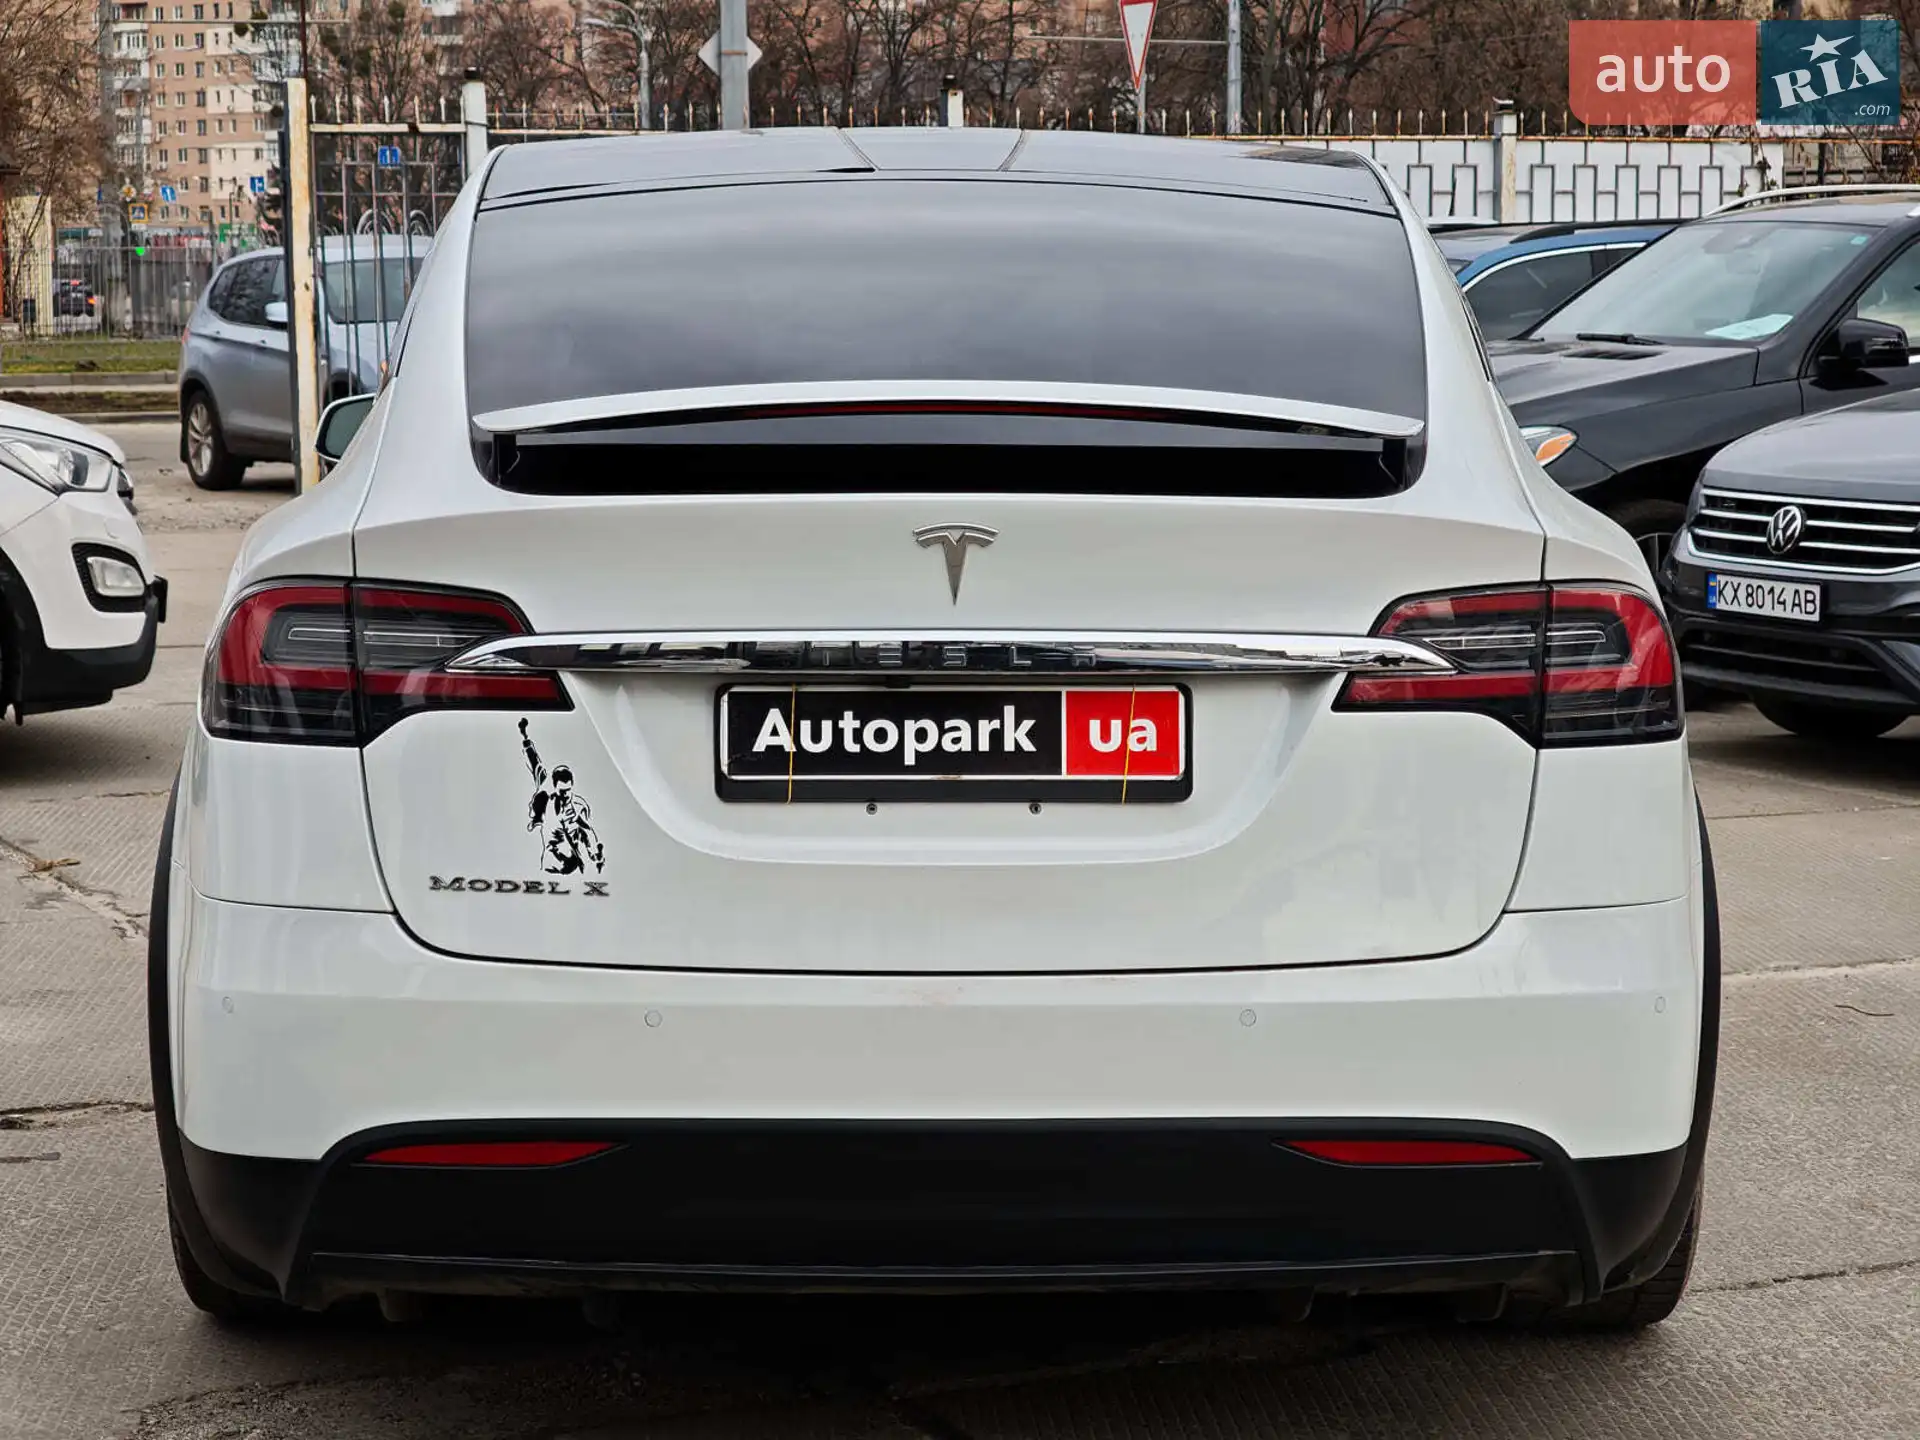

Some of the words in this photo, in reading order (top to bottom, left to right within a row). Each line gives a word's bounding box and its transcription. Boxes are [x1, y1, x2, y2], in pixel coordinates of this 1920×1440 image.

[1718, 579, 1741, 607] KX
[1745, 583, 1787, 613] 8014
[1790, 588, 1818, 616] AB
[752, 704, 1037, 766] Autopark
[1088, 717, 1159, 752] ua
[429, 875, 571, 895] MODEL
[583, 881, 611, 897] X
